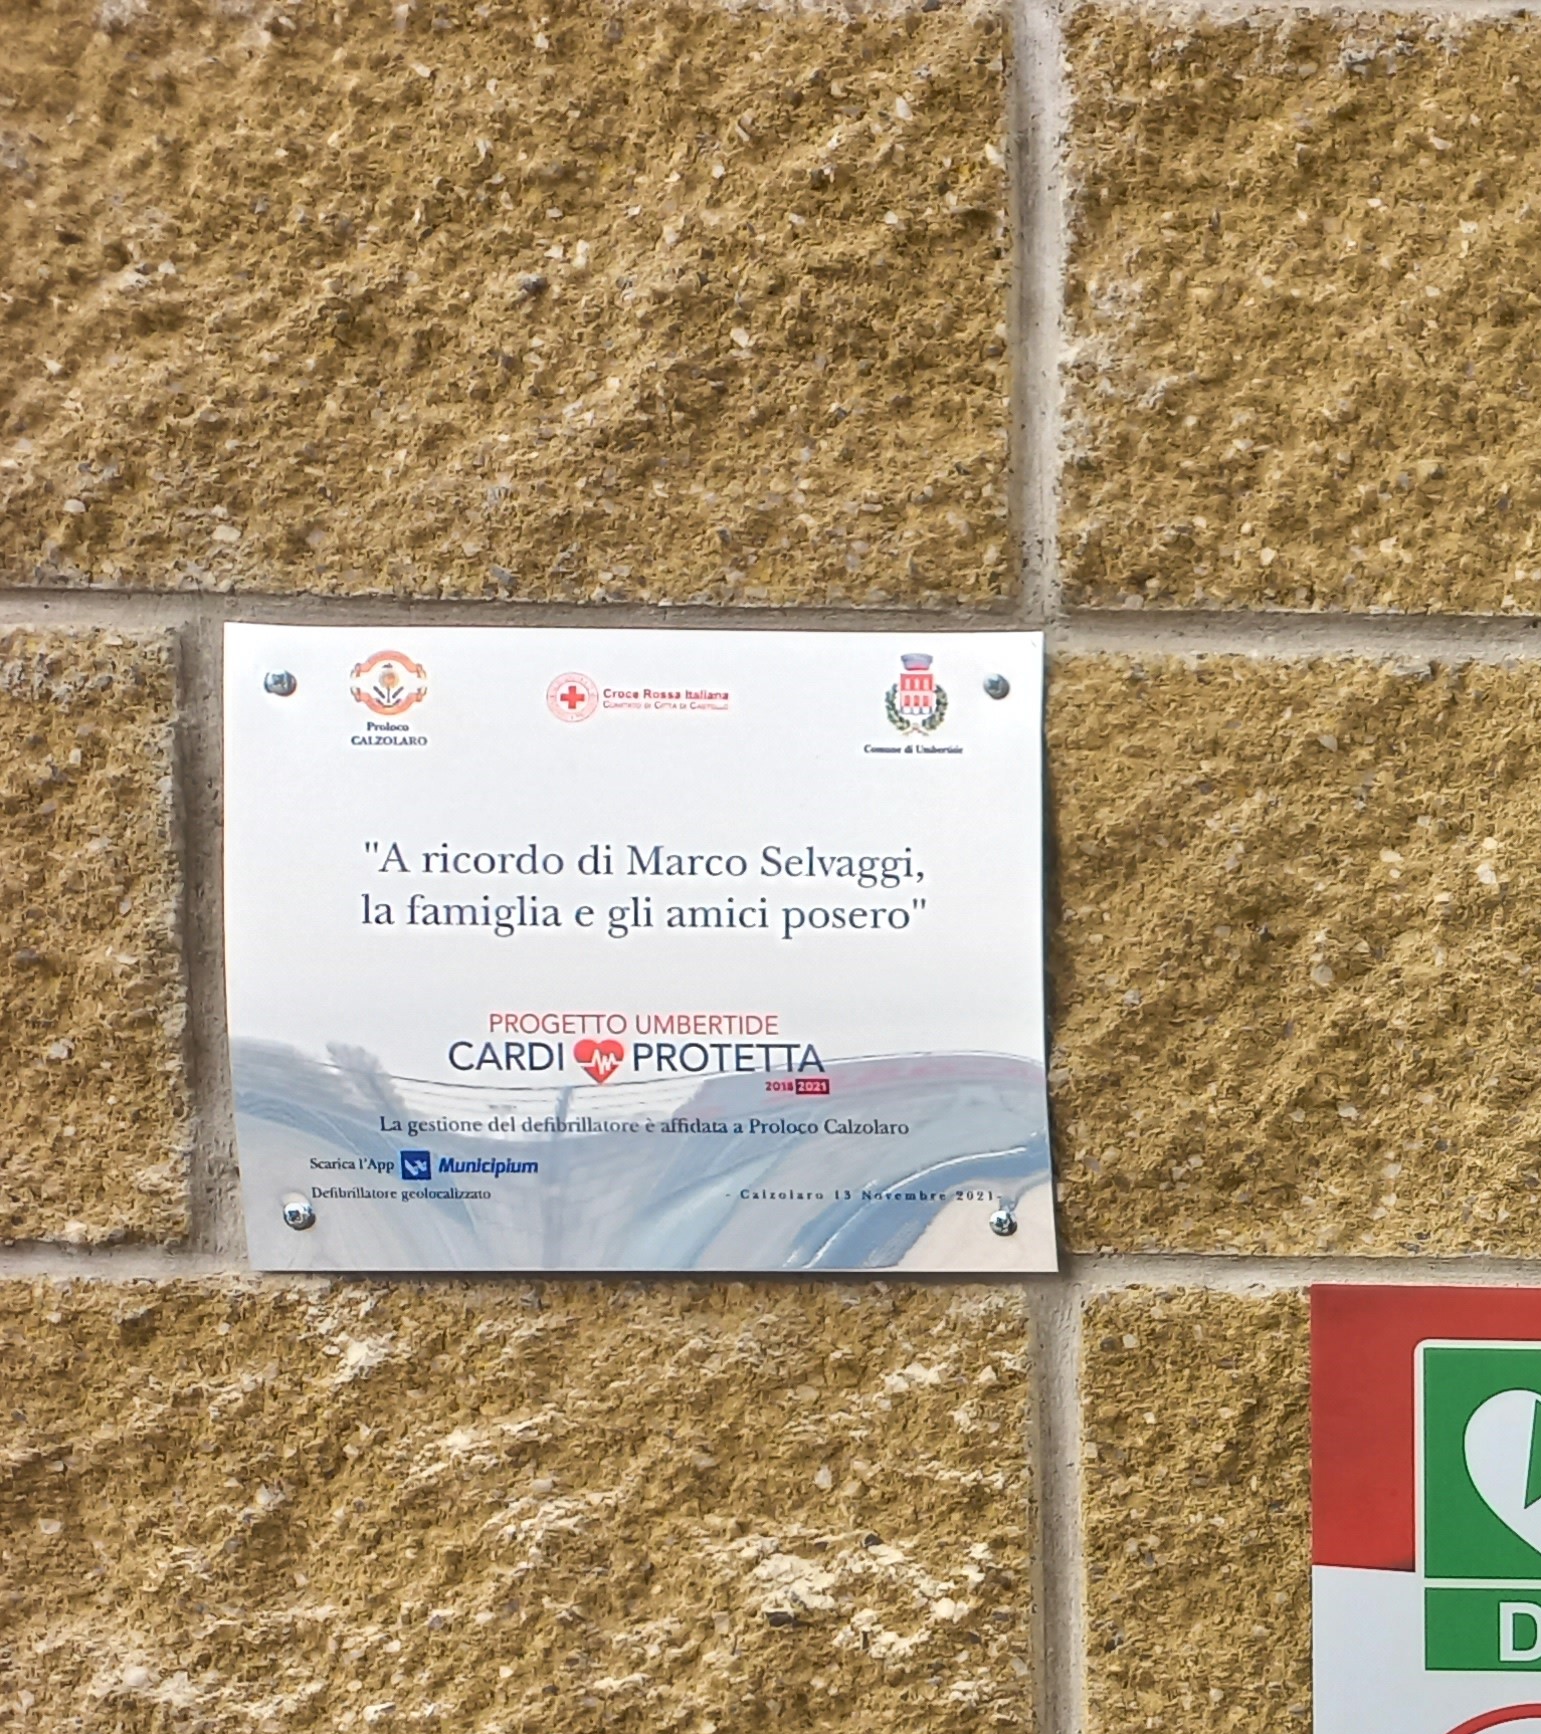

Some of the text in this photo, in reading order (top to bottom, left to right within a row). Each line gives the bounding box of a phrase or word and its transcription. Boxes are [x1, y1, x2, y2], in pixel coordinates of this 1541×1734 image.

[366, 721, 410, 732] Proloco
[350, 735, 428, 746] CALZOLARO
[364, 842, 923, 888] "A ricordo di Marco Selvaggi,
[362, 894, 925, 939] la famiglia e gli amici posero"
[490, 1014, 778, 1035] PROGETTO UMBERTIDE
[448, 1041, 826, 1072] CARDI PROTETTA
[380, 1116, 909, 1137] La gestione del defibrillatore è affidata a Proloco Calzolaro
[310, 1158, 355, 1169] Scarica
[439, 1158, 538, 1178] Municipium
[312, 1187, 491, 1201] Defibrillatore geolocalizzato
